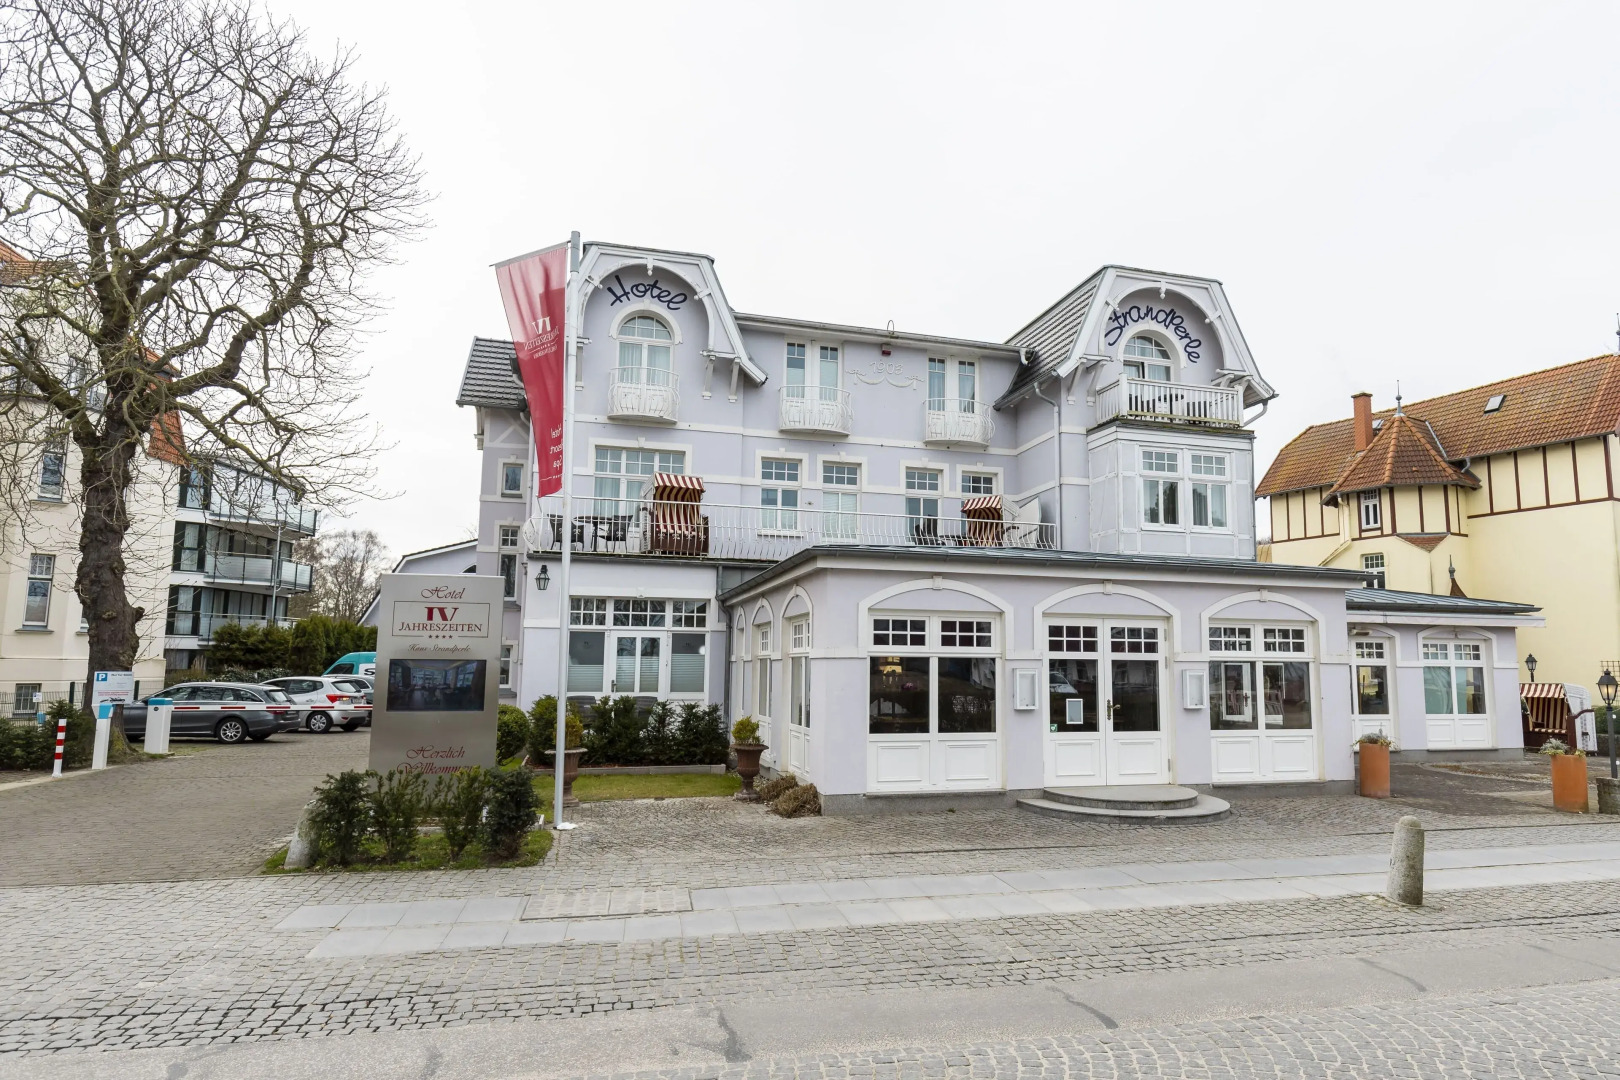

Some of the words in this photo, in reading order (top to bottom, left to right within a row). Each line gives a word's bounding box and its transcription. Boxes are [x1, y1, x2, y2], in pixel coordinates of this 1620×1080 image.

[607, 275, 687, 310] Hotel
[421, 586, 465, 599] Hotel
[425, 606, 459, 622] IV
[399, 622, 482, 632] JAHRESZEITEN
[406, 745, 465, 759] Herzlich
